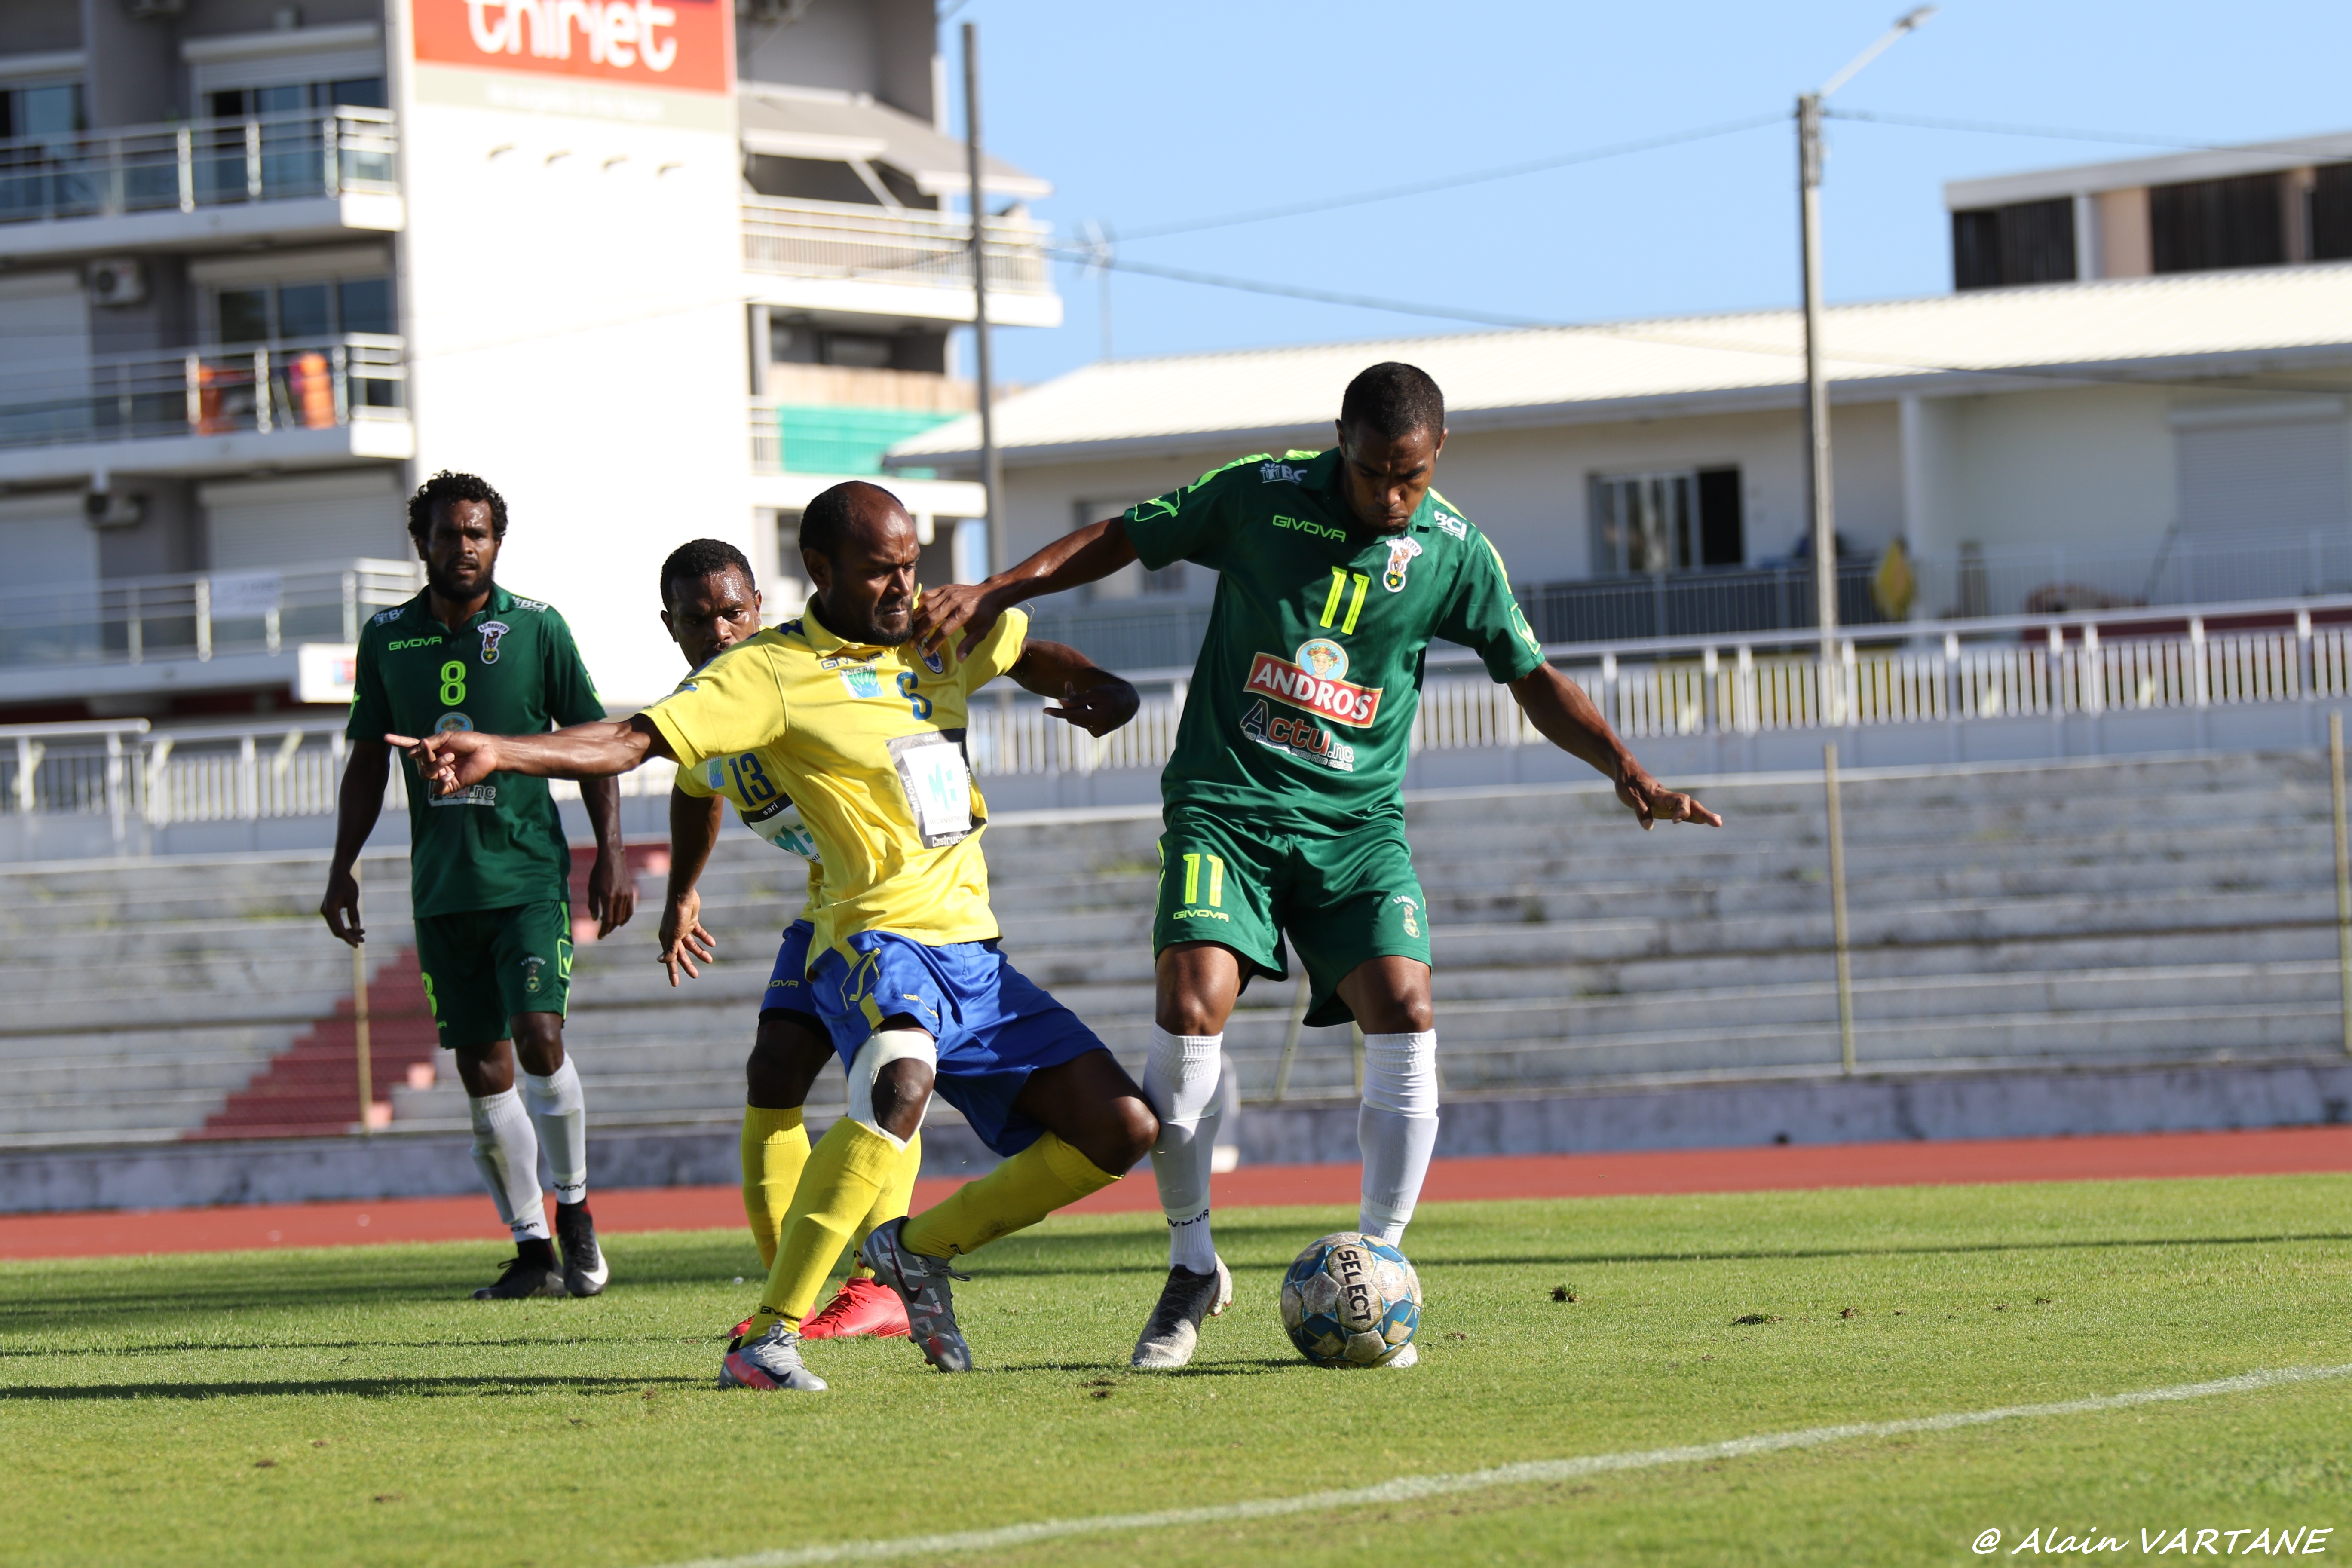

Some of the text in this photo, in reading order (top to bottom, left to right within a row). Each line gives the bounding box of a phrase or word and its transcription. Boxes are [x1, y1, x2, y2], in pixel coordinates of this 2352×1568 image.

[1272, 514, 1346, 542] GIVOVA
[1434, 510, 1467, 536] BCI
[1320, 566, 1370, 635] 11
[389, 636, 443, 651] GIVOVA
[440, 660, 467, 706] 8
[1253, 662, 1373, 720] ANDROS
[924, 732, 939, 742] sarl
[1240, 698, 1354, 763] Actu.nc
[728, 752, 777, 807] 13
[903, 775, 921, 812] IMPORT
[763, 802, 778, 816] sarl
[1183, 853, 1224, 908] 11
[1173, 909, 1230, 923] GIVOVA
[1337, 1250, 1372, 1322] SELECT
